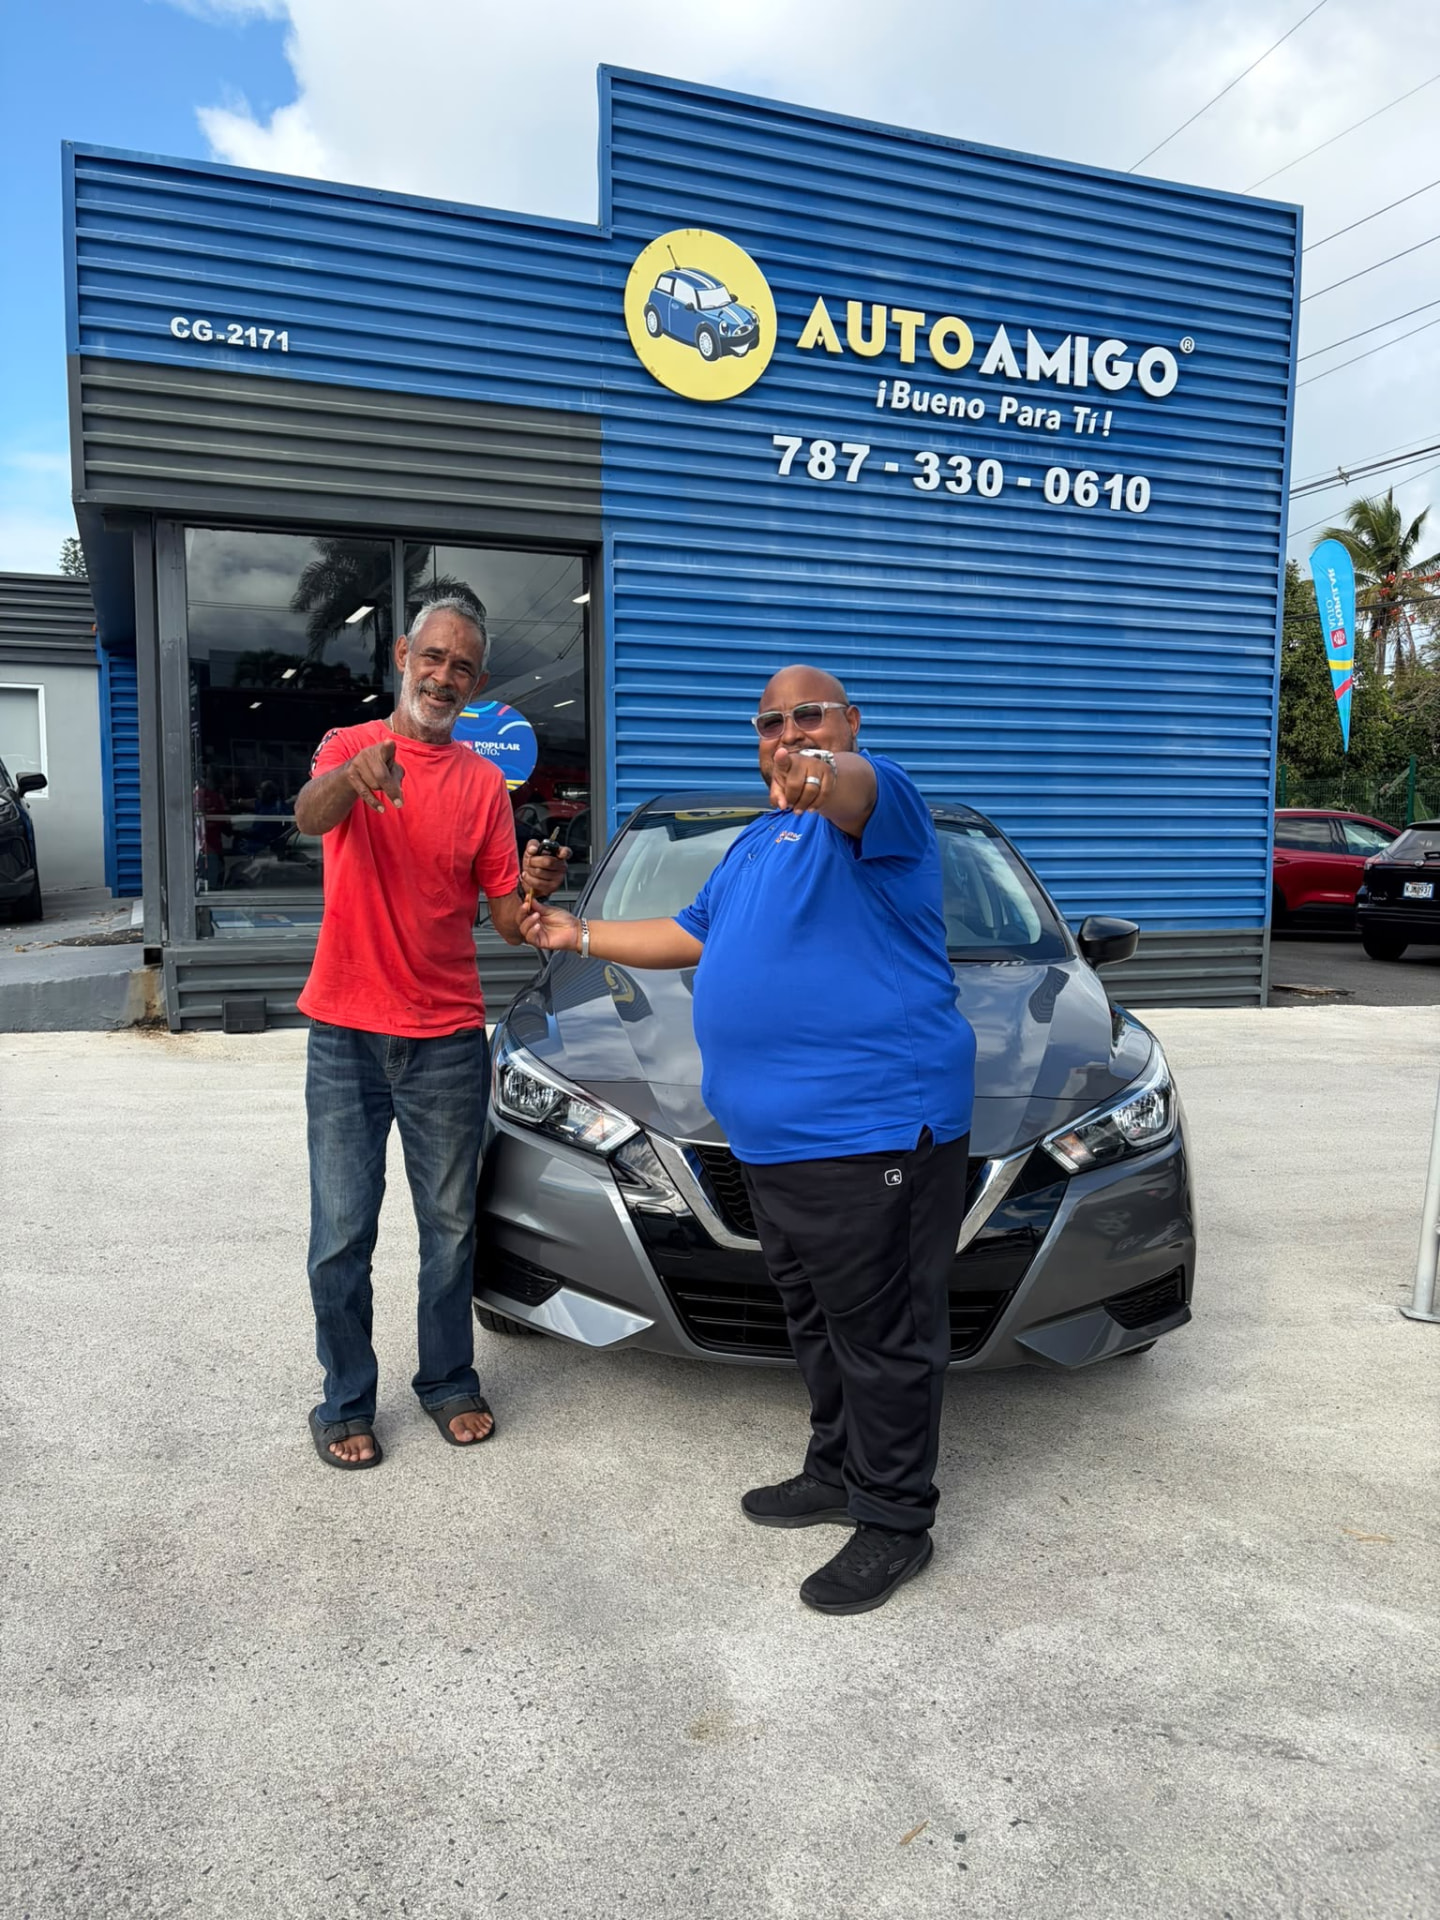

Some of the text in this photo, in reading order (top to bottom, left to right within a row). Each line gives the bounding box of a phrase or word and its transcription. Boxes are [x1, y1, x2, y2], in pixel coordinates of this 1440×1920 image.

[170, 316, 289, 352] CG-2171
[999, 396, 1061, 430] Para
[474, 741, 521, 751] POPULAR
